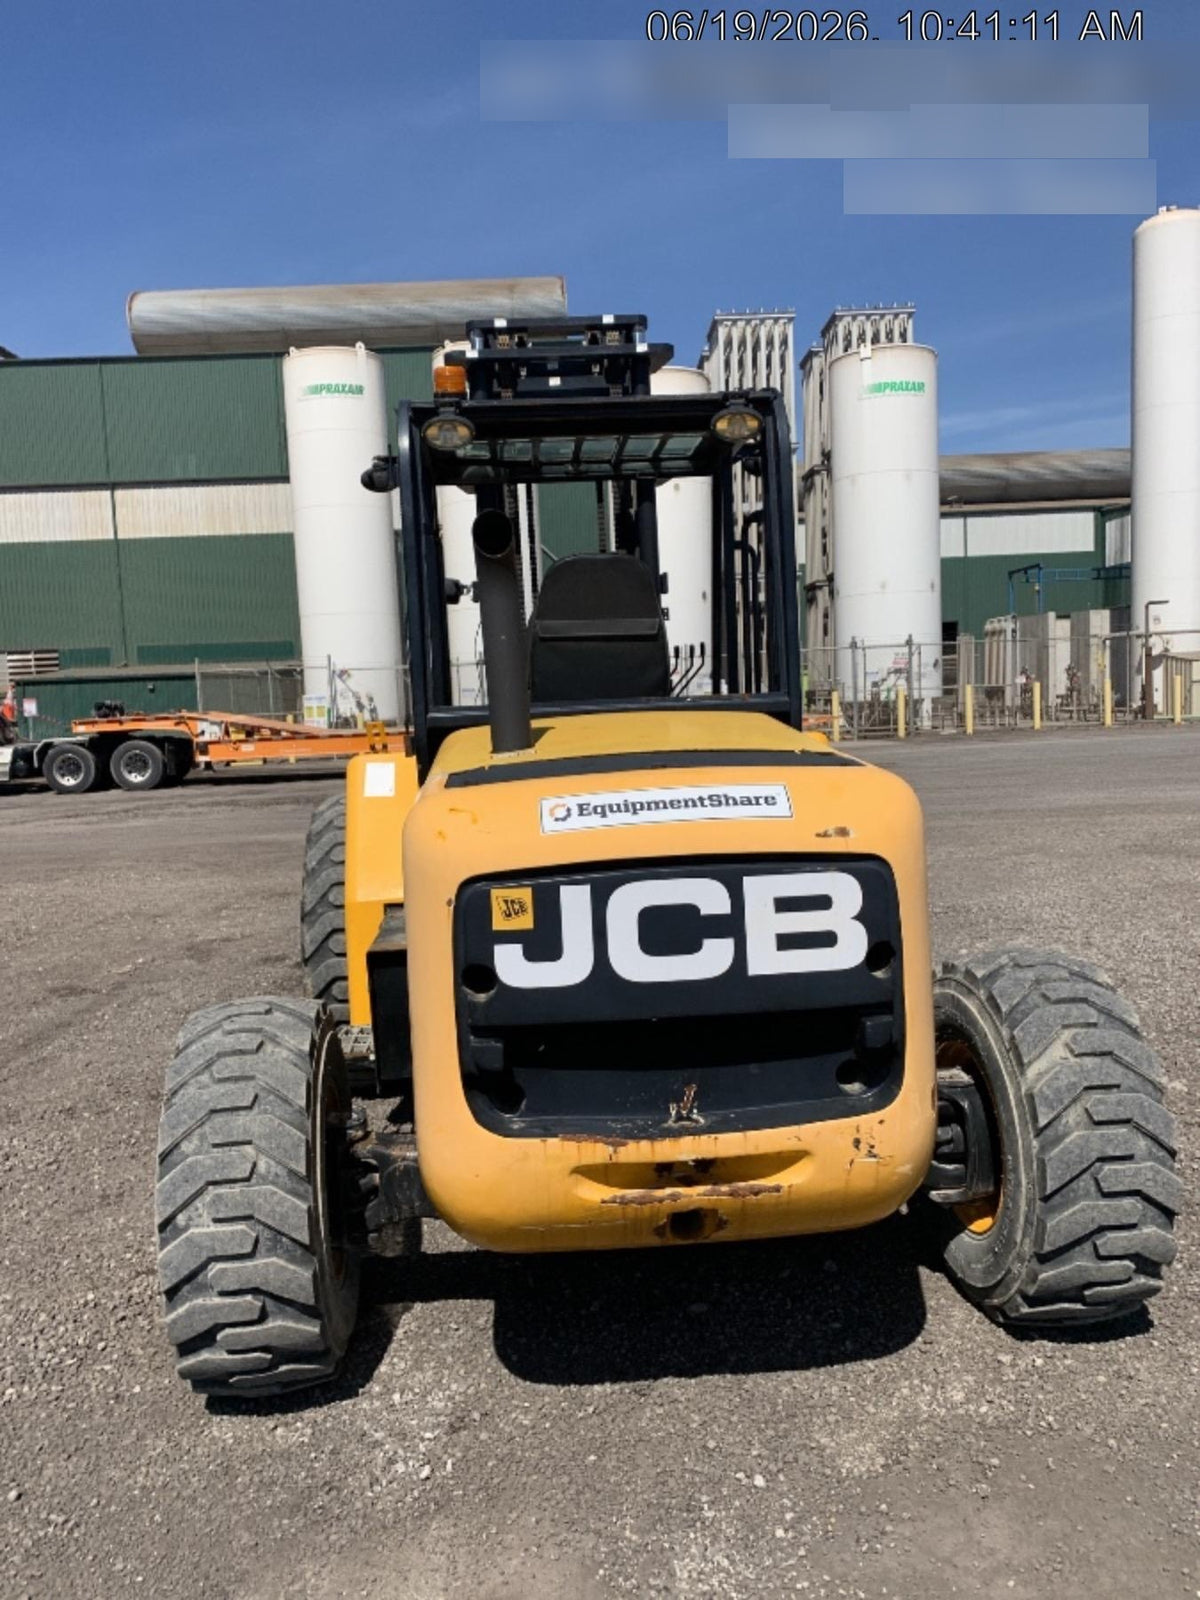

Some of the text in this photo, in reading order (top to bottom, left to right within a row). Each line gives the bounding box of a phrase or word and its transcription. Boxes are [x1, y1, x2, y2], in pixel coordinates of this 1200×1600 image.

[577, 793, 777, 818] EquipmentShare
[500, 897, 528, 919] JCB
[494, 872, 868, 989] JCB
